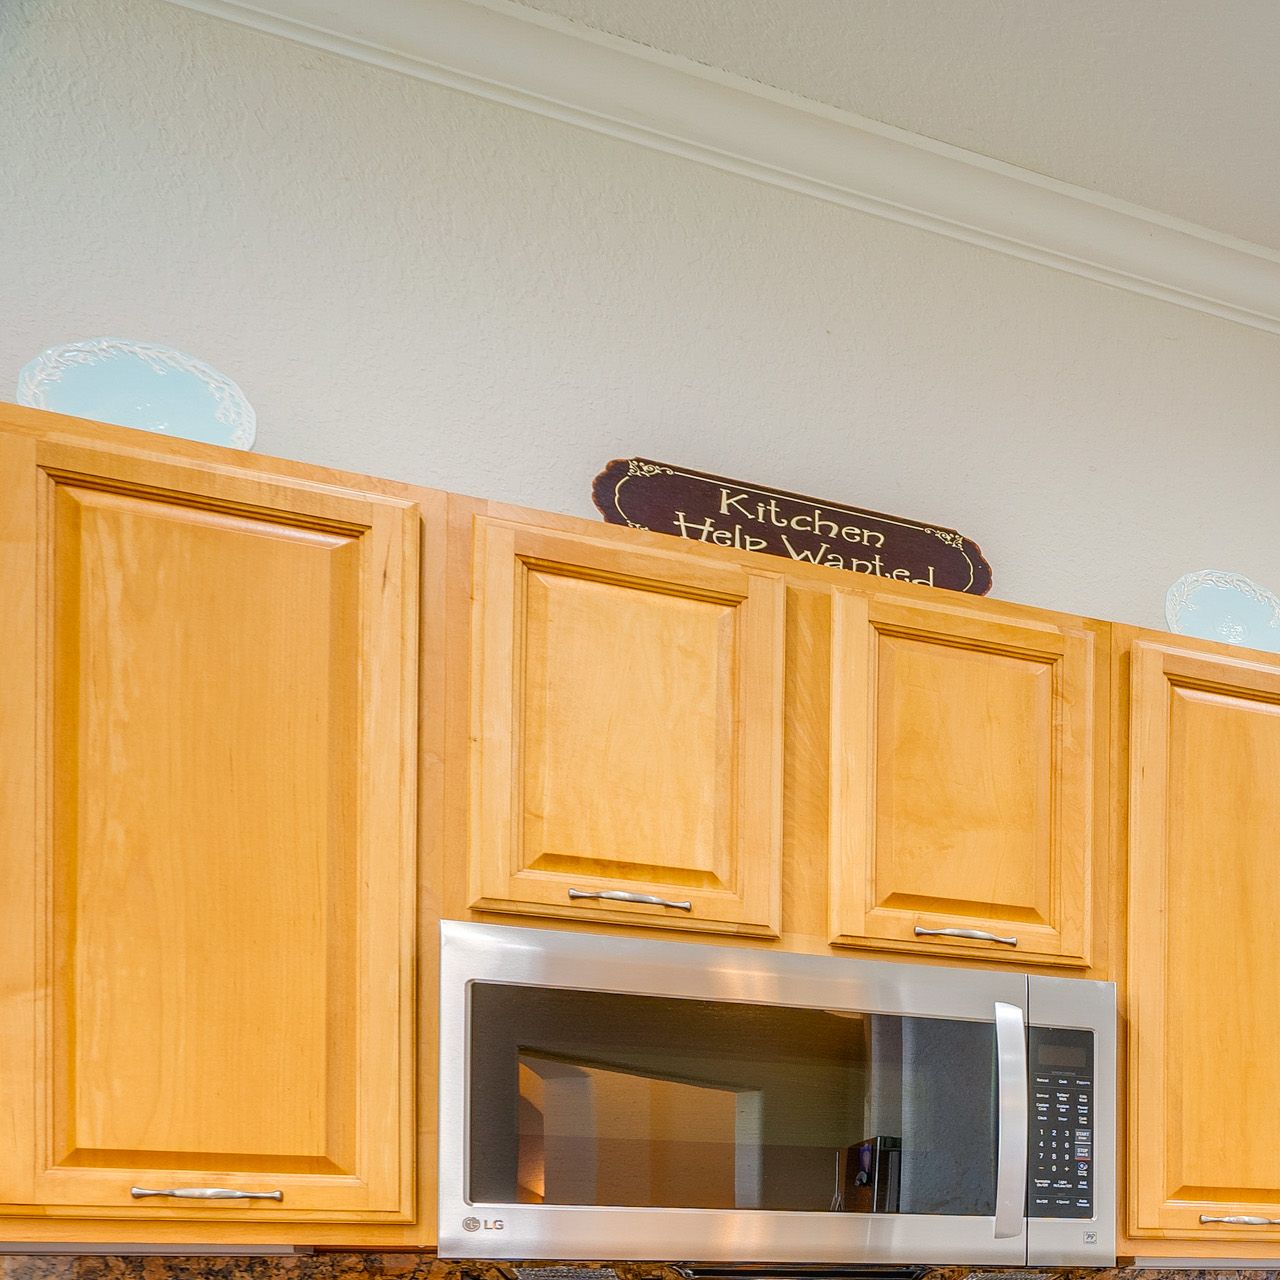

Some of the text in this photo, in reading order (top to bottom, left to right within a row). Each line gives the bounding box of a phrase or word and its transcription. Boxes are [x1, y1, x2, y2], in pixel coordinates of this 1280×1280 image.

[673, 511, 768, 552] Help
[719, 488, 885, 548] Kitchen
[484, 1219, 504, 1230] LG
